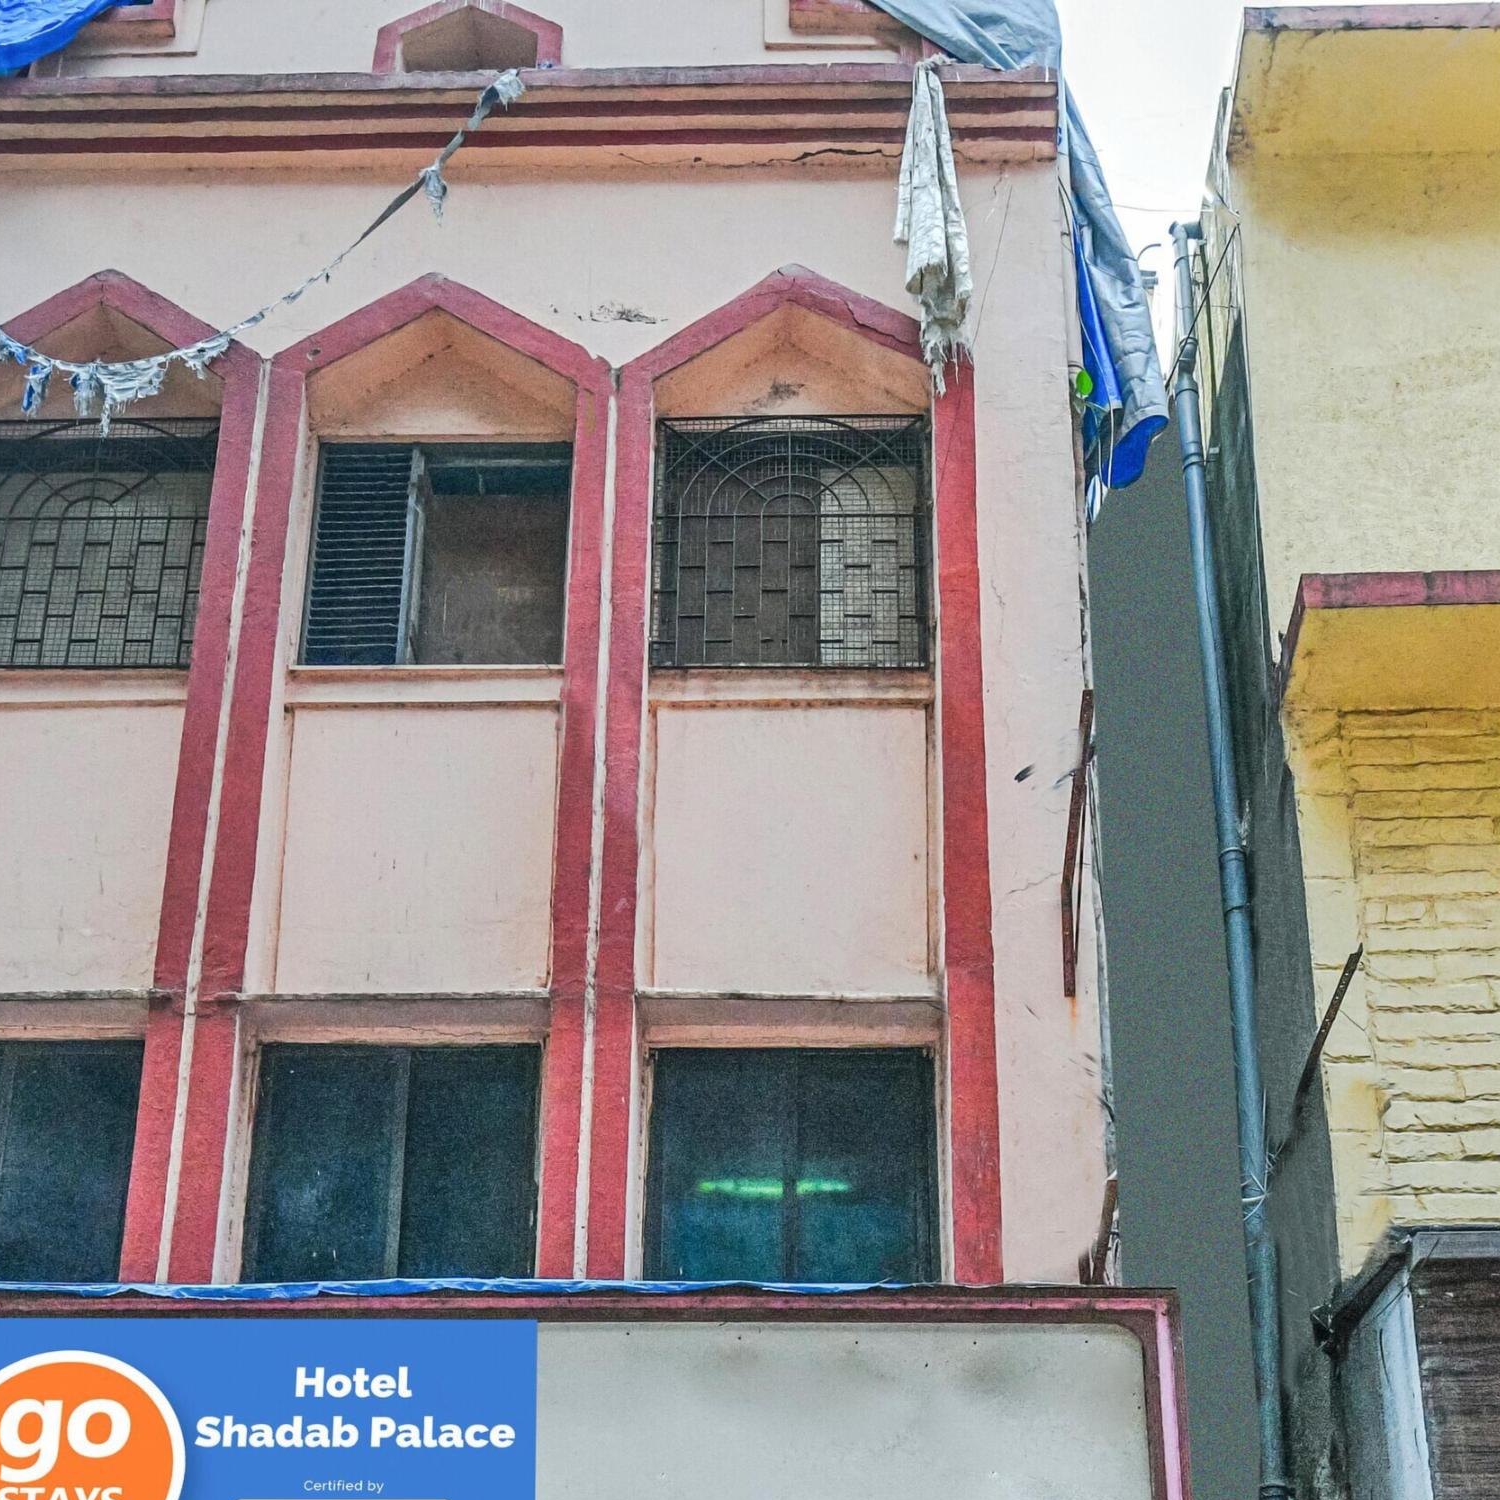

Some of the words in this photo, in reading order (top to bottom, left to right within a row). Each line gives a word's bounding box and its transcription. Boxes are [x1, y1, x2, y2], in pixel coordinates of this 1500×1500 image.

[295, 1366, 412, 1398] Hotel
[195, 1416, 359, 1448] Shadab
[370, 1416, 516, 1448] Palace
[303, 1479, 363, 1492] Certified
[367, 1479, 384, 1494] by
